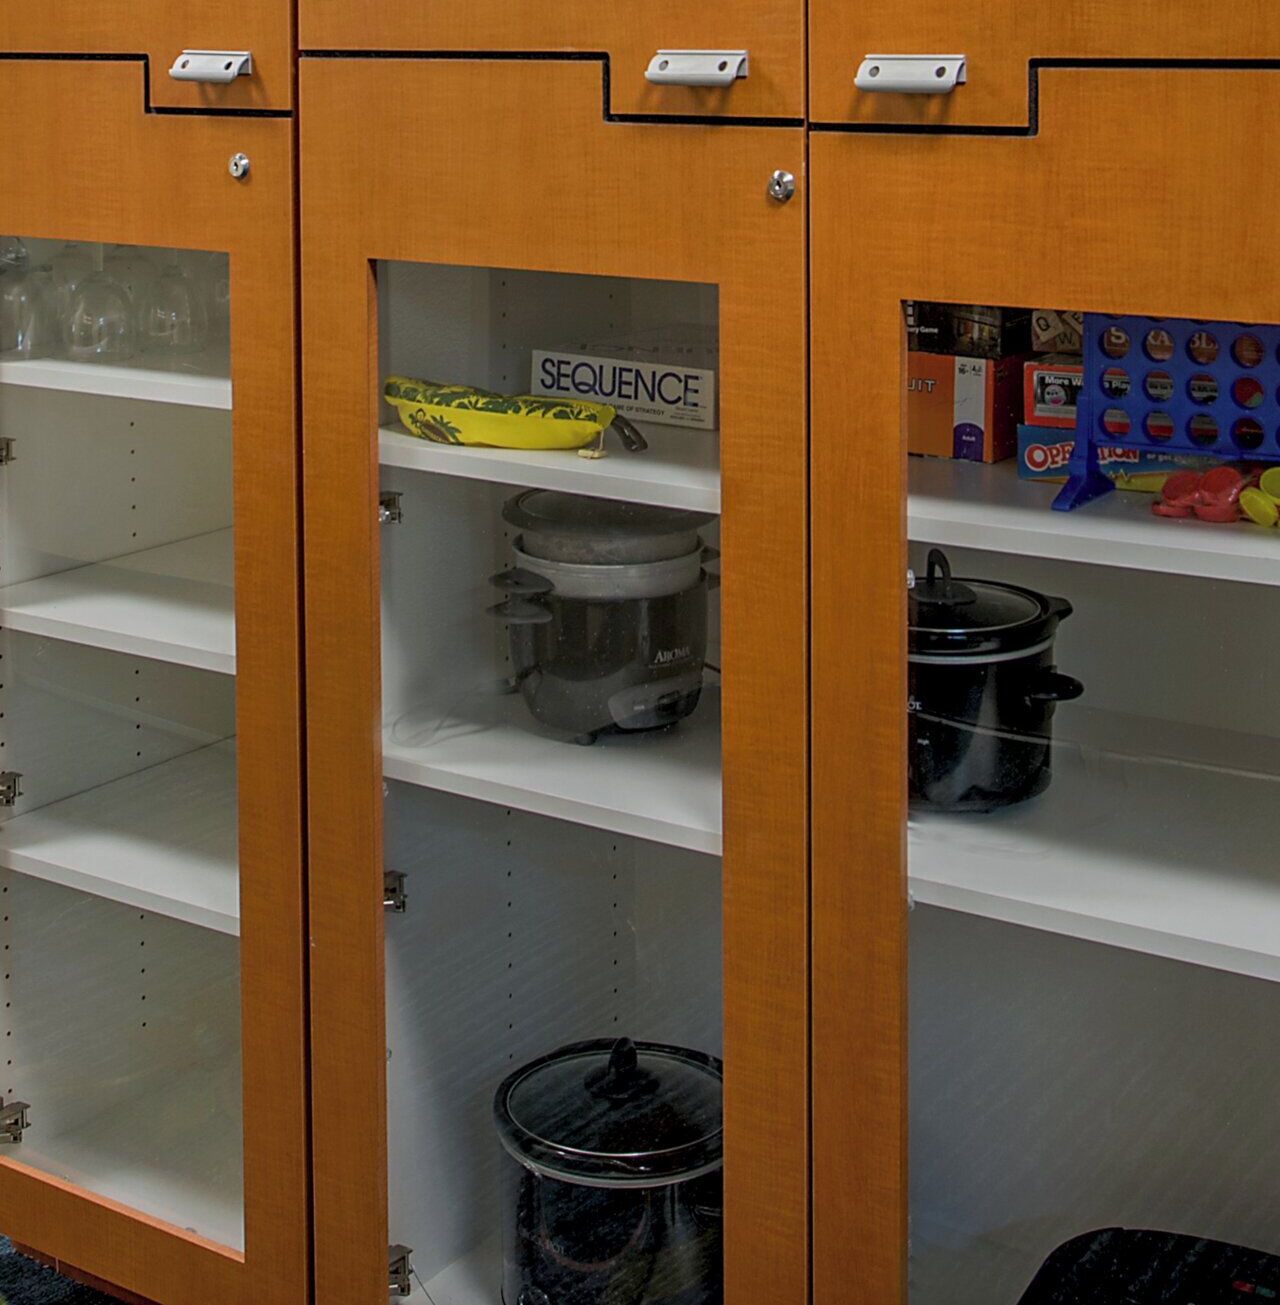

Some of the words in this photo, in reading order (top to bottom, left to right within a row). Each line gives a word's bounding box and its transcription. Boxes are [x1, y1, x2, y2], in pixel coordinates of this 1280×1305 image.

[1036, 316, 1050, 332] Q
[540, 357, 699, 407] SEQUENCE
[1045, 376, 1069, 385] More
[635, 407, 665, 416] STRATEGY
